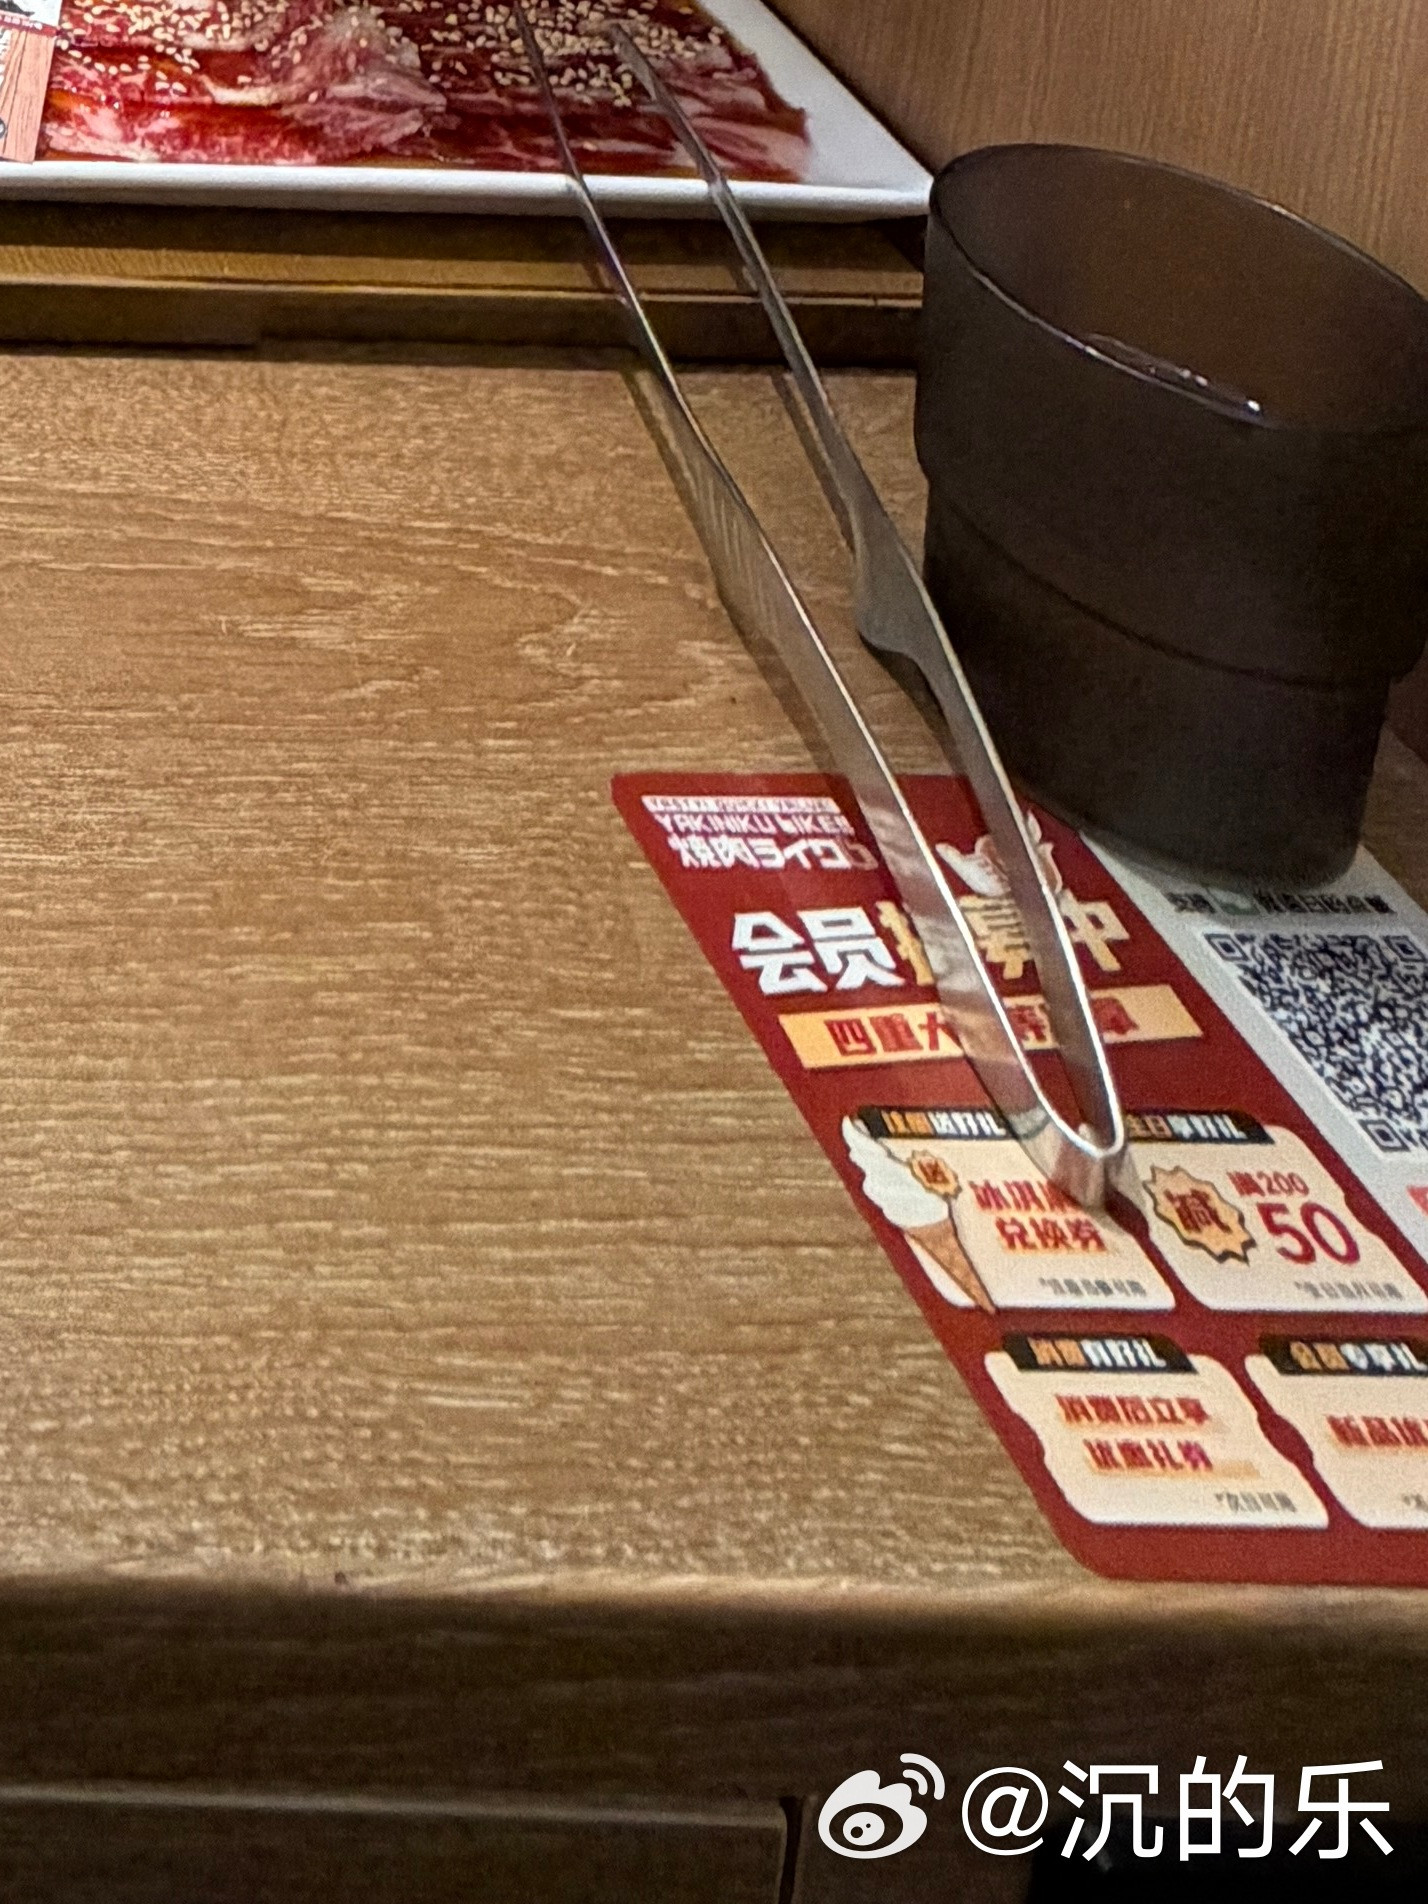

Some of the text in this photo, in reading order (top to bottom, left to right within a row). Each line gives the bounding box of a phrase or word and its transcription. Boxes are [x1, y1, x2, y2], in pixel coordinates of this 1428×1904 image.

[653, 813, 778, 835] YAKINIKU
[1225, 1170, 1310, 1197] 满200
[1162, 1188, 1234, 1235] 减
[995, 1216, 1107, 1252] 兑换券
[1256, 1200, 1361, 1266] 50
[1325, 1414, 1428, 1449] 新品优
